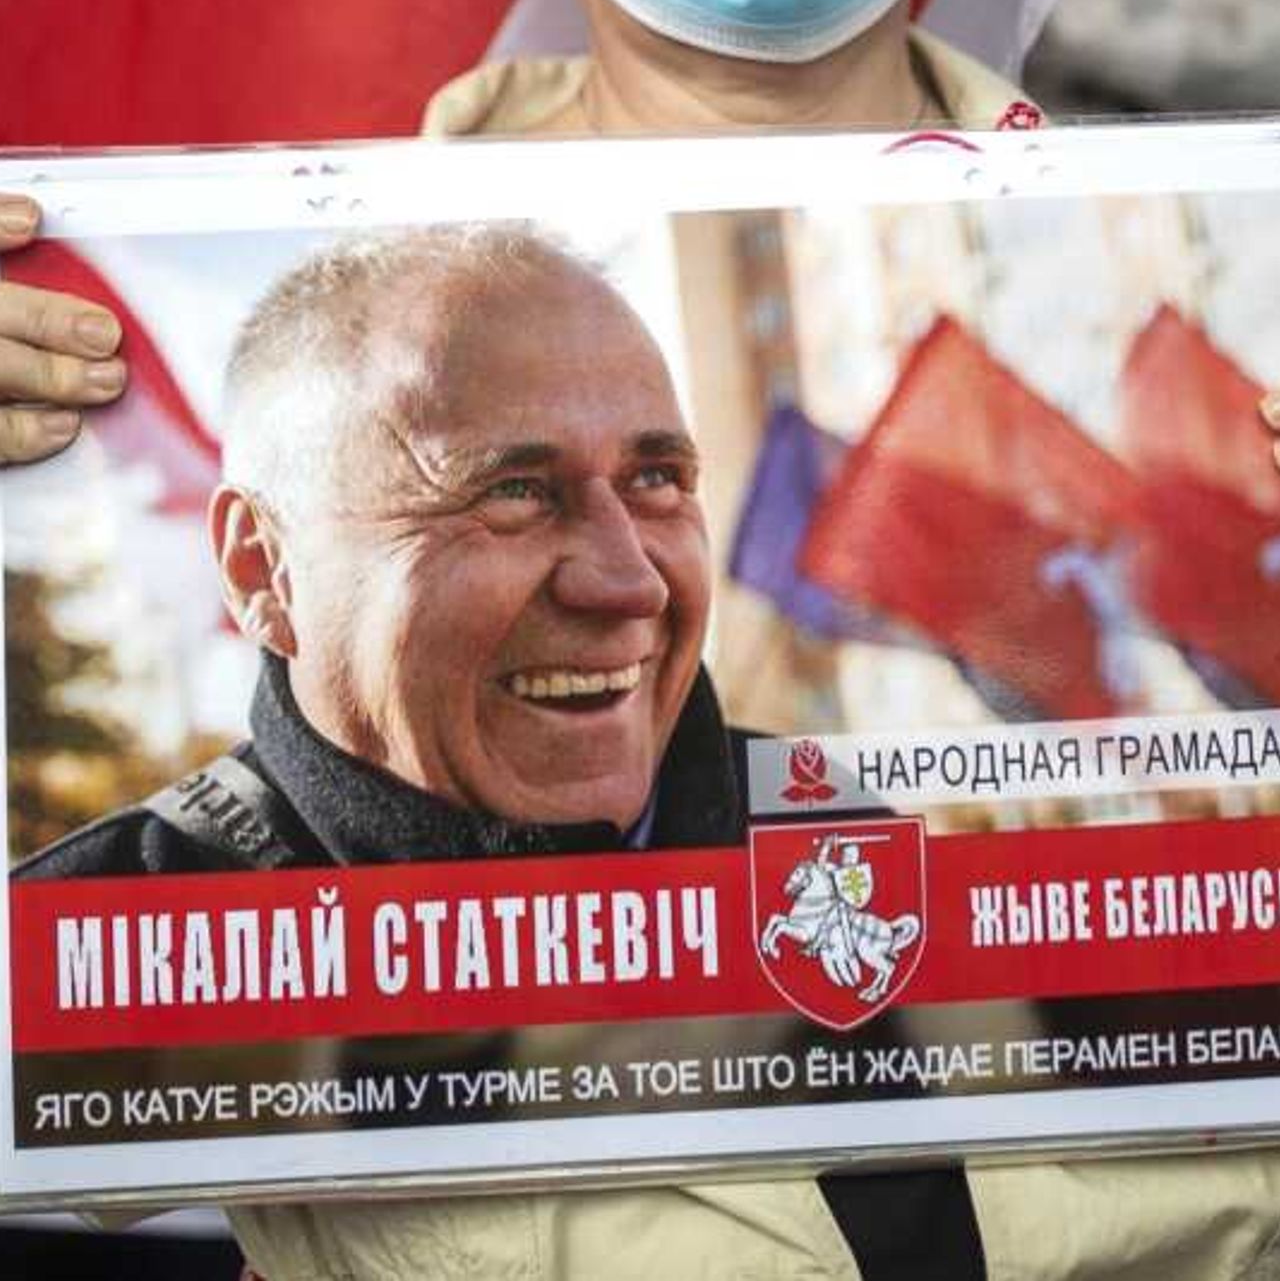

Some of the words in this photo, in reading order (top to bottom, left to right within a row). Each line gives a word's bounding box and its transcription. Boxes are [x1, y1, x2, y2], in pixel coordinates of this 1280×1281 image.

[857, 737, 1081, 791] НАРОДНАЯ
[56, 887, 347, 1009] МІКАЛАЙ
[372, 886, 718, 995] СТАТКЕВІЧ
[969, 880, 1092, 947] ЖЫВЕ
[34, 1094, 111, 1130] ЯГО
[123, 1086, 237, 1125] КАТУЕ
[250, 1078, 396, 1118] РЭЖЫМ
[404, 1075, 429, 1110] У
[438, 1066, 560, 1106] ТУРМЕ
[572, 1063, 620, 1099] ЗА
[627, 1060, 700, 1097] ТОЕ
[713, 1055, 794, 1091] ШТО
[807, 1049, 855, 1087] ЁН
[864, 1044, 992, 1087] ЖАДАЕ
[1005, 1032, 1176, 1076] ПЕРАМЕН
